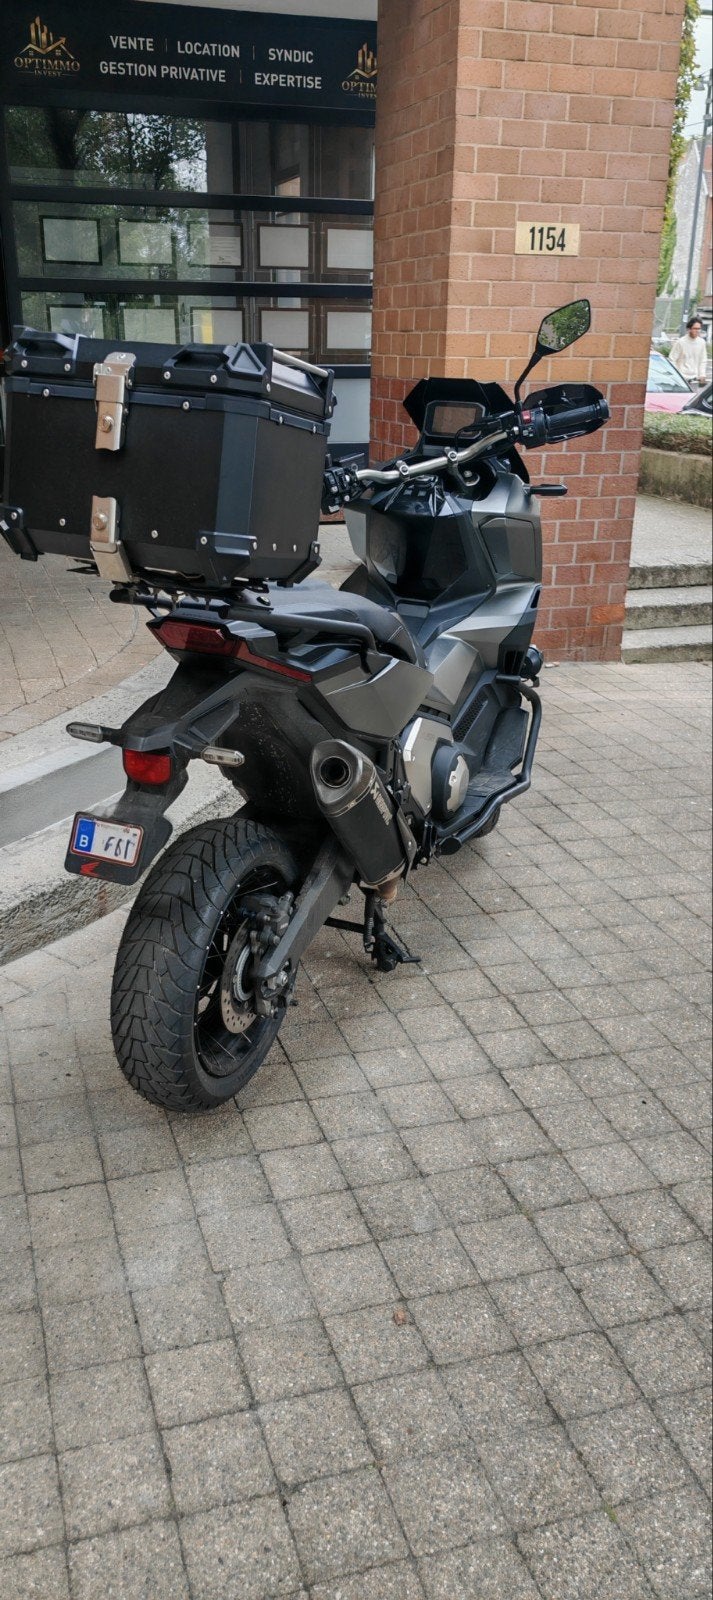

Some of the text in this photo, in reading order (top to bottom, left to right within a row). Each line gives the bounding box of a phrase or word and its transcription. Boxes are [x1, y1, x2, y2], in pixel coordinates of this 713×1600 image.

[110, 35, 314, 64] VENTE LOCATION SYNDIC
[14, 56, 81, 72] OPTIMMO
[34, 69, 62, 77] INVEST
[99, 61, 322, 90] GESTION PRIVATIVE EXPERTISE
[530, 226, 566, 252] 1154
[79, 834, 89, 848] B
